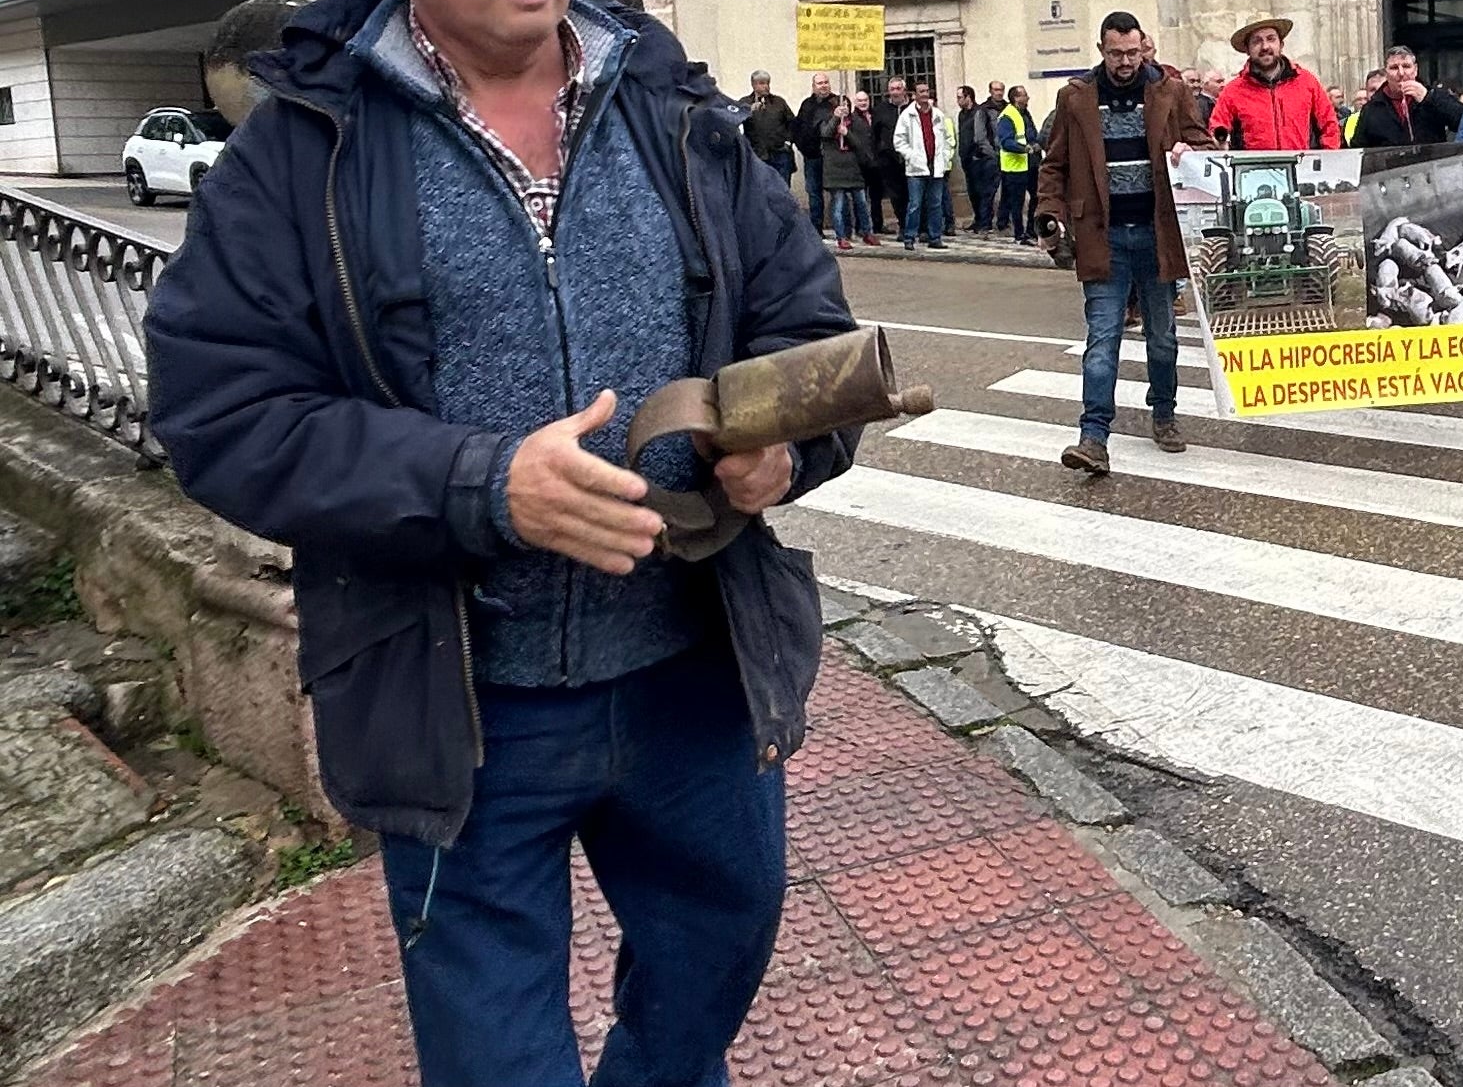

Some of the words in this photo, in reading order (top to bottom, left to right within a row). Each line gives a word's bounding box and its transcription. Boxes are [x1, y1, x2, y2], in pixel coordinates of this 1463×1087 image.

[1249, 348, 1275, 372] LA
[1279, 334, 1397, 370] HIPOCRESÍA
[1400, 339, 1414, 362] Y
[1418, 337, 1444, 360] LA
[1241, 384, 1268, 408] LA
[1272, 377, 1373, 406] DESPENSA
[1377, 366, 1426, 399] ESTÁ
